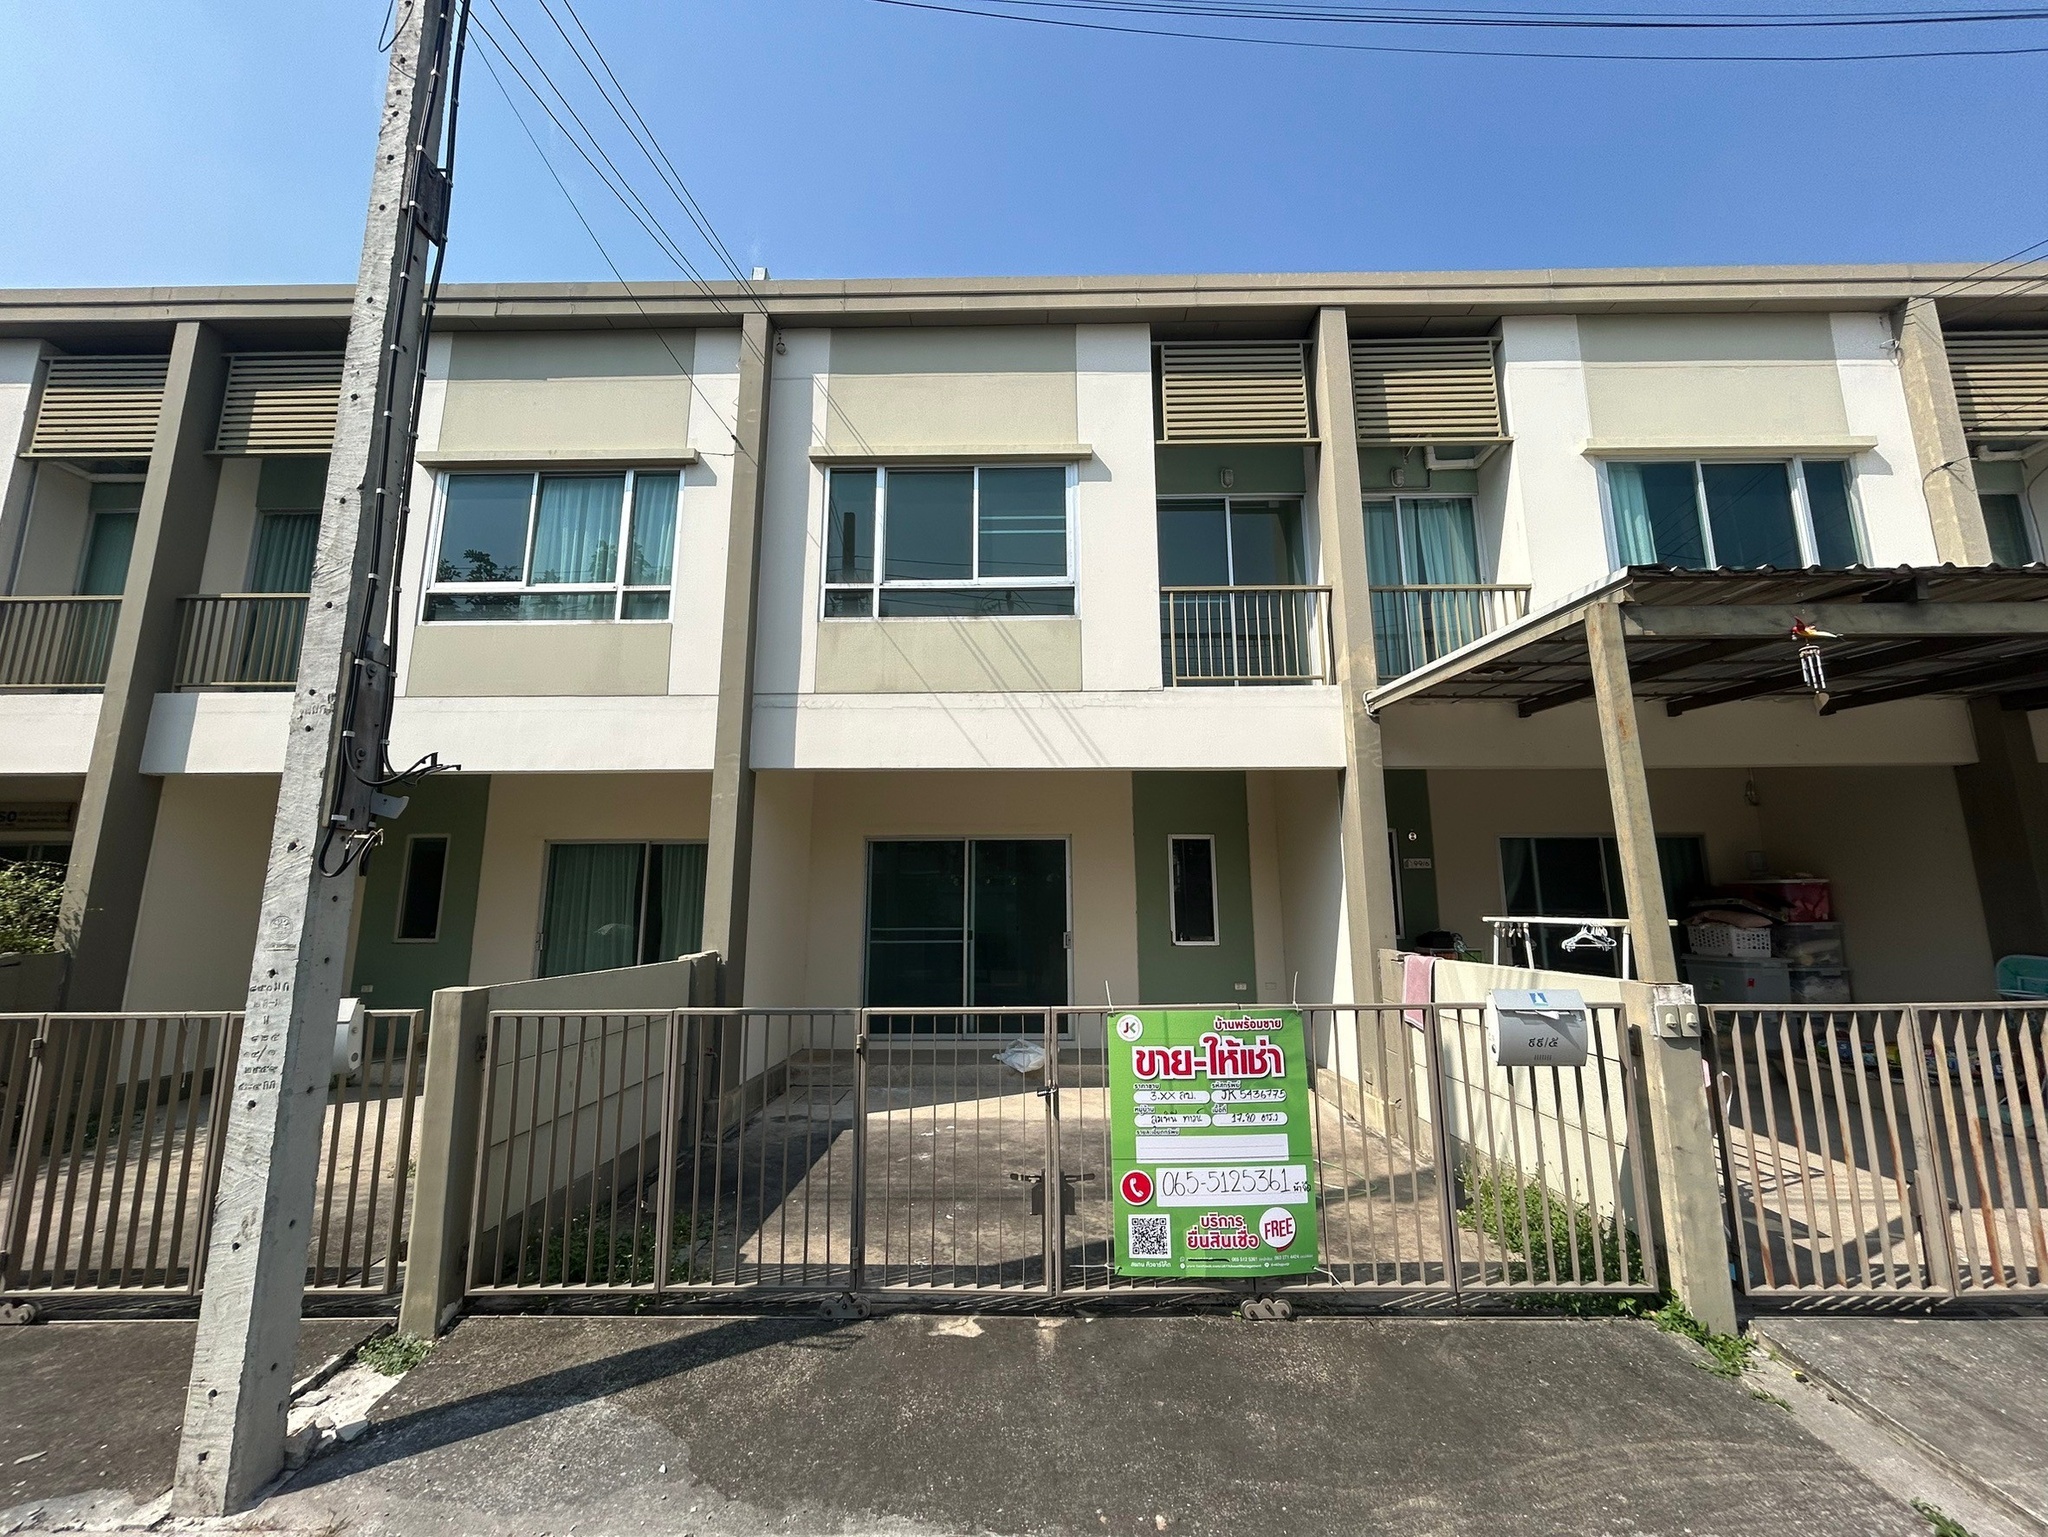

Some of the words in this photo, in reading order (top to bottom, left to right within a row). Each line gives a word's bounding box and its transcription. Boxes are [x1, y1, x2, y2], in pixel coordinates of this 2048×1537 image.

[1214, 1016, 1282, 1030] บ้านพร้อมขาย
[1135, 1036, 1282, 1076] ขาย-ให้เช่า
[1220, 1089, 1237, 1101] JK
[1162, 1168, 1291, 1197] 065-5125361
[1200, 1213, 1244, 1228] บริการ
[1264, 1217, 1294, 1240] FREE
[1187, 1226, 1259, 1249] ยื่นสินเชื่อ
